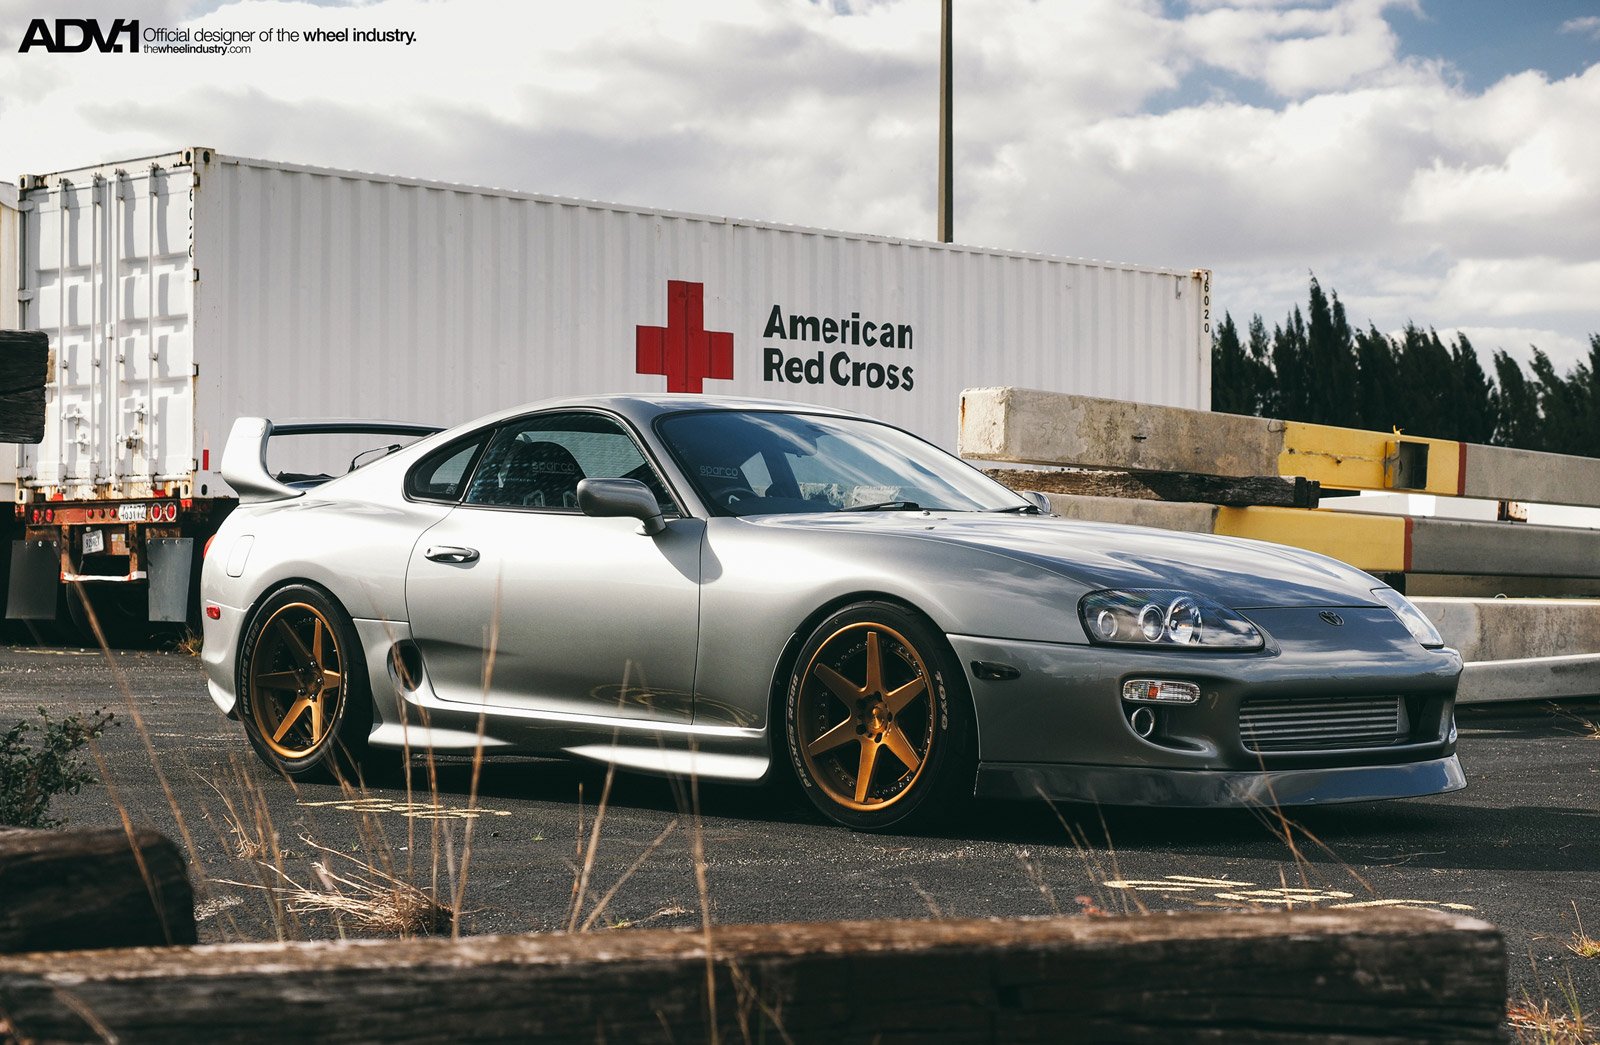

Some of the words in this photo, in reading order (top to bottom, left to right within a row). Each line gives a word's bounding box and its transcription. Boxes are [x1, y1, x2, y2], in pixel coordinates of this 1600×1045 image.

[763, 304, 913, 348] American
[763, 347, 824, 384] Red
[829, 351, 914, 391] Cross
[531, 461, 575, 474] sparco
[700, 465, 739, 478] sparco
